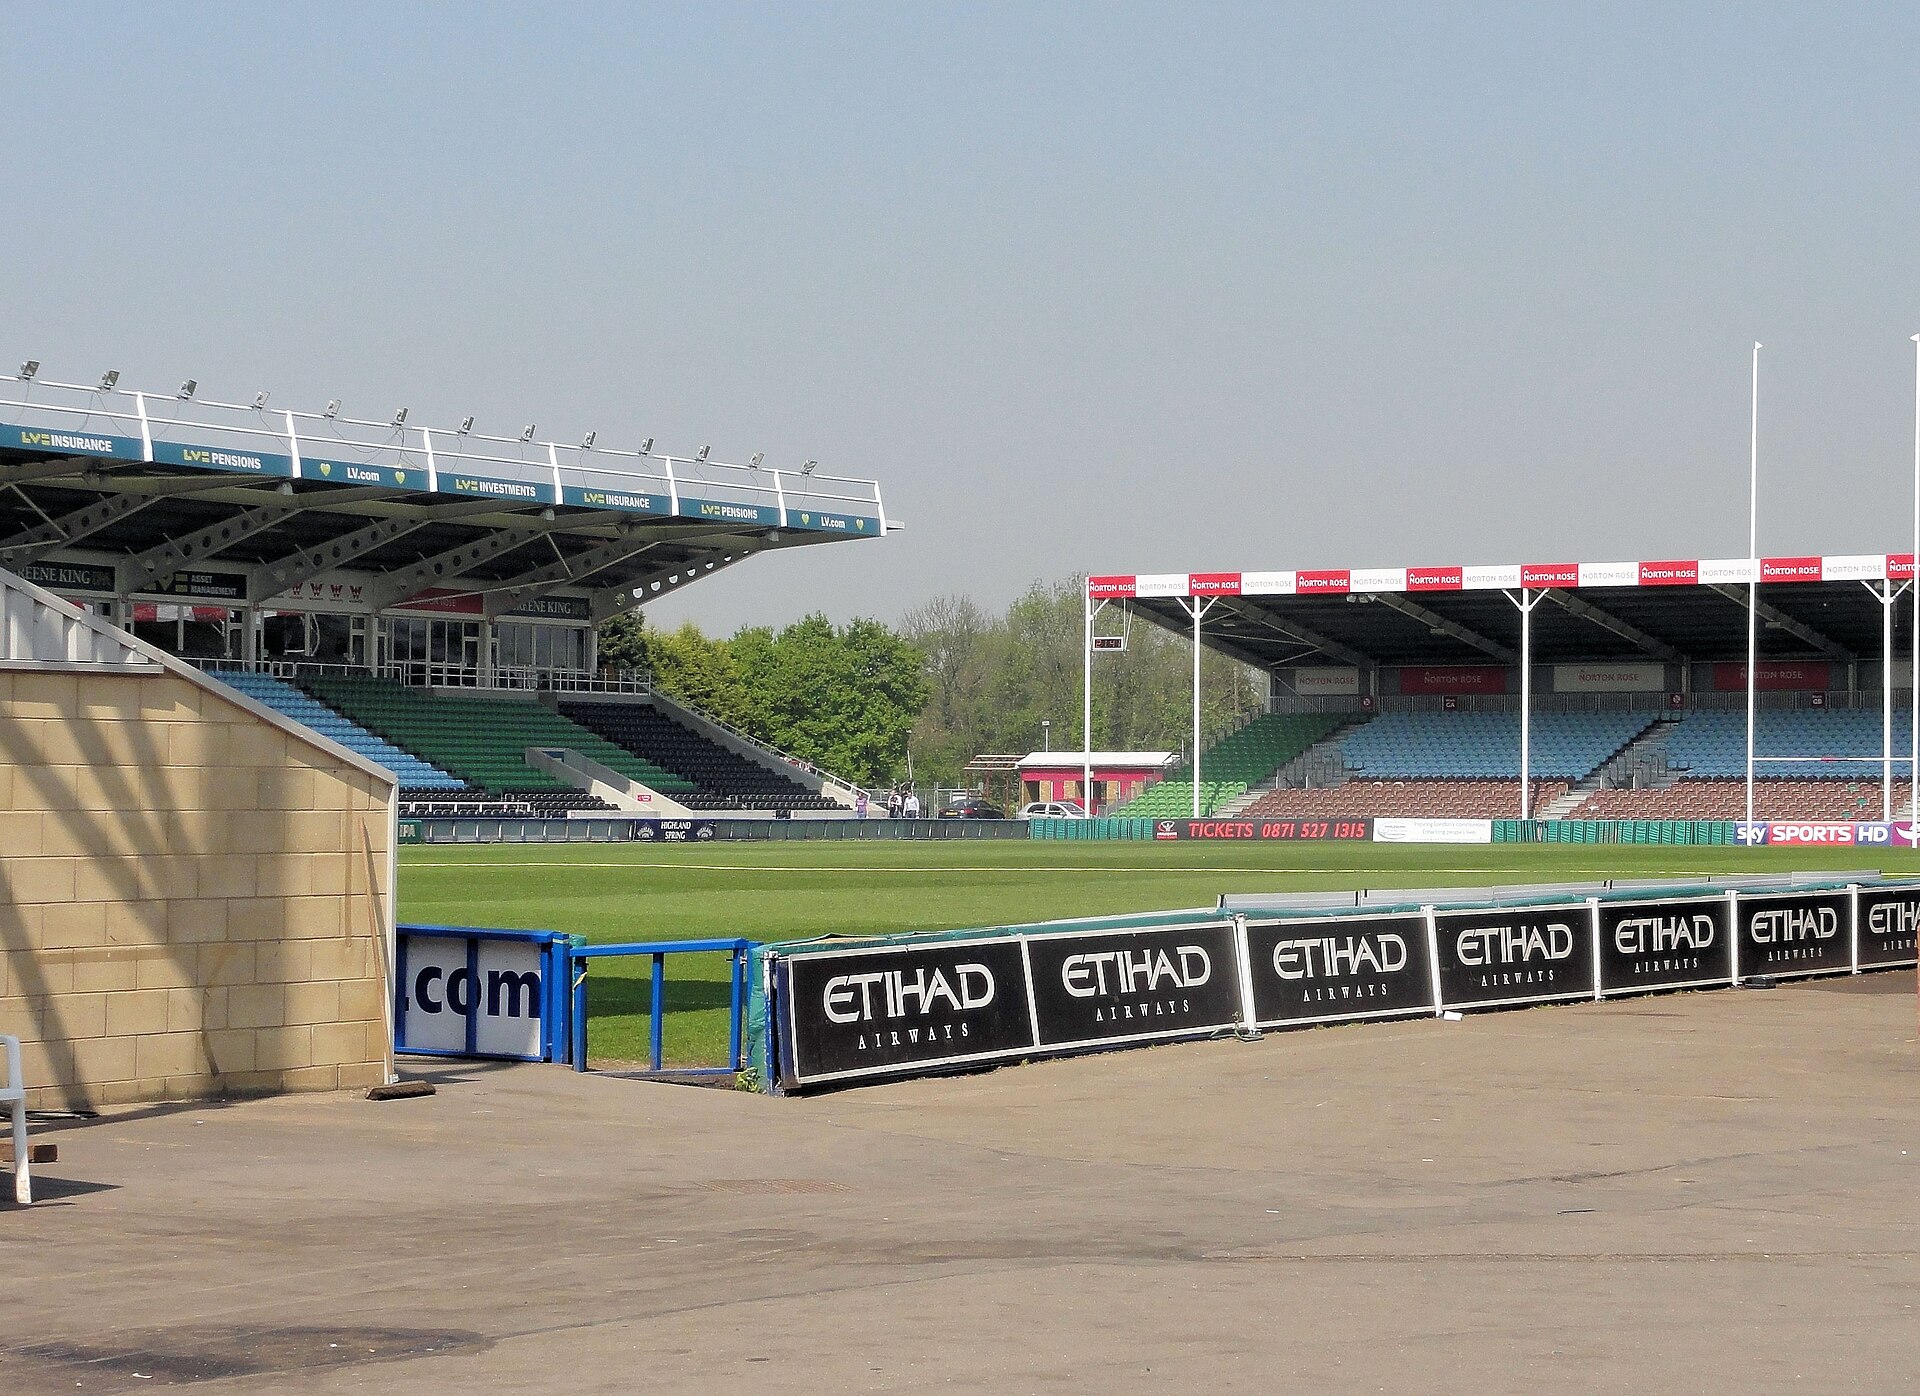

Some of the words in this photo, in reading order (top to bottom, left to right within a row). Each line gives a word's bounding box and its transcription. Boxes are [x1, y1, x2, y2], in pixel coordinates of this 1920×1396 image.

[51, 434, 112, 452] INSURANCE
[212, 452, 261, 470] PENSIONS
[347, 467, 380, 482] LV.com
[479, 481, 536, 497] INVESTMENTS
[605, 494, 650, 509] INSURANCE
[721, 505, 758, 520] PENSIONS
[821, 516, 846, 529] LV.com
[17, 565, 57, 582] REENE
[59, 568, 91, 584] KING
[1582, 571, 1614, 580] NORTON
[1615, 570, 1635, 579] ROSE
[1641, 569, 1674, 579] NORTON
[1675, 568, 1696, 578] ROSE
[1702, 568, 1735, 577] NORTON
[1763, 565, 1797, 576] NORTON
[1798, 565, 1820, 575] ROSE
[1826, 565, 1859, 574] NORTON
[1860, 564, 1882, 573] ROSE
[191, 574, 212, 584] ASSET
[1245, 580, 1273, 588] NORTON
[1299, 578, 1328, 588] NORTON
[1330, 578, 1348, 587] ROSE
[1353, 578, 1383, 586] NORTON
[1385, 577, 1403, 585] ROSE
[1409, 576, 1440, 585] NORTON
[1441, 575, 1460, 584] ROSE
[1466, 575, 1496, 583] NORTON
[1498, 574, 1517, 582] ROSE
[1523, 572, 1555, 582] NORTON
[1556, 572, 1577, 581] ROSE
[1090, 583, 1117, 592] NORTON
[1118, 584, 1136, 592] ROSE
[1168, 582, 1186, 590] ROSE
[1192, 582, 1220, 590] NORTON
[1221, 581, 1239, 589] ROSE
[547, 601, 571, 614] KING
[1460, 675, 1482, 684] ROSE
[1616, 672, 1639, 682] ROSE
[661, 821, 691, 830] HIGHLAND
[1189, 823, 1253, 837] TICKETS
[1261, 823, 1295, 838] 0871
[1301, 823, 1328, 838] 527
[1334, 823, 1365, 838] 1315
[664, 831, 686, 840] SPRING
[1773, 826, 1851, 842] SPORTS
[1858, 826, 1889, 842] HD
[1751, 907, 1837, 944] ETIHAD
[1615, 915, 1715, 954] ETIHAD
[1456, 923, 1573, 966] ETIHAD
[1273, 933, 1407, 980] ETIHAD
[1768, 946, 1823, 962] AIRWAYS
[1062, 945, 1211, 998] ETIHAD
[1634, 956, 1698, 974] AIRWAYS
[1481, 969, 1554, 987] AIRWAYS
[405, 965, 541, 1019] com
[823, 963, 995, 1024] ETIHAD
[1303, 983, 1388, 1002] AIRWAYS
[1095, 1000, 1190, 1022] AIRWAYS
[858, 1022, 970, 1051] AIRWAYS
